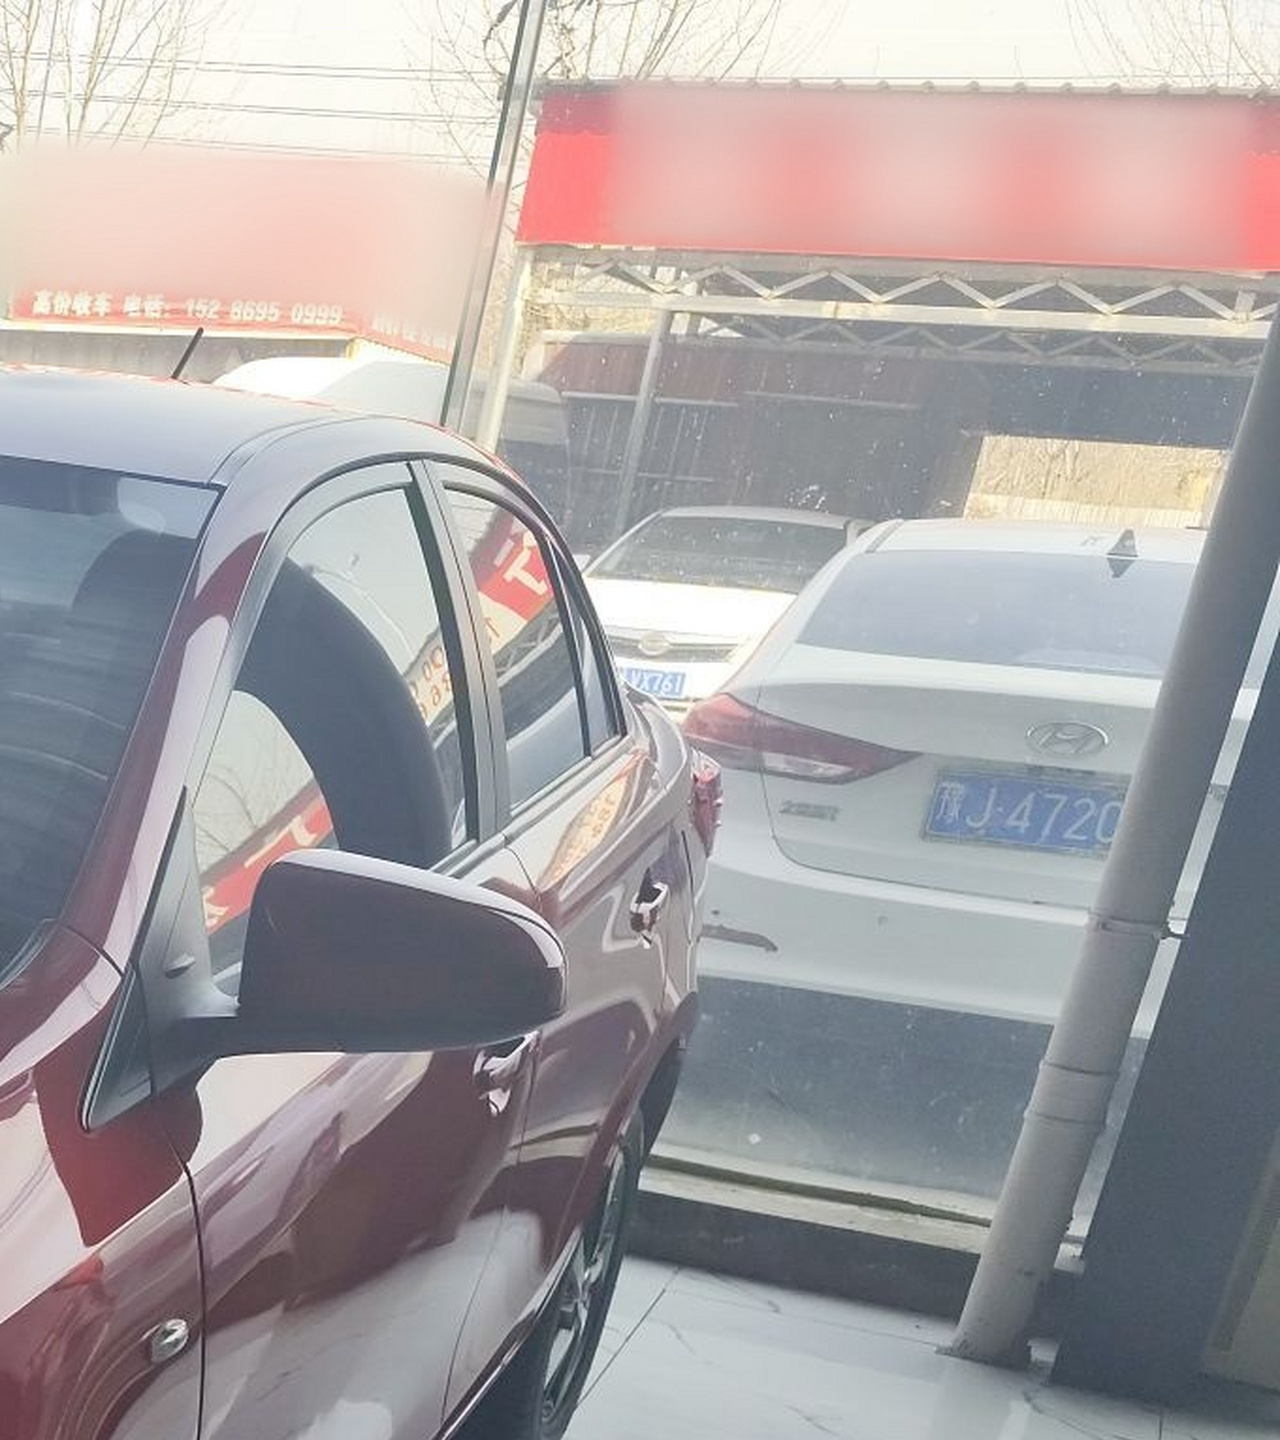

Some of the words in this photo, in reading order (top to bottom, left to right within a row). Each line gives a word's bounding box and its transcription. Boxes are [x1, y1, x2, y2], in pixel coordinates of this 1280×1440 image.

[185, 297, 221, 319] 152
[229, 299, 281, 322] 8695
[291, 302, 344, 325] 0999
